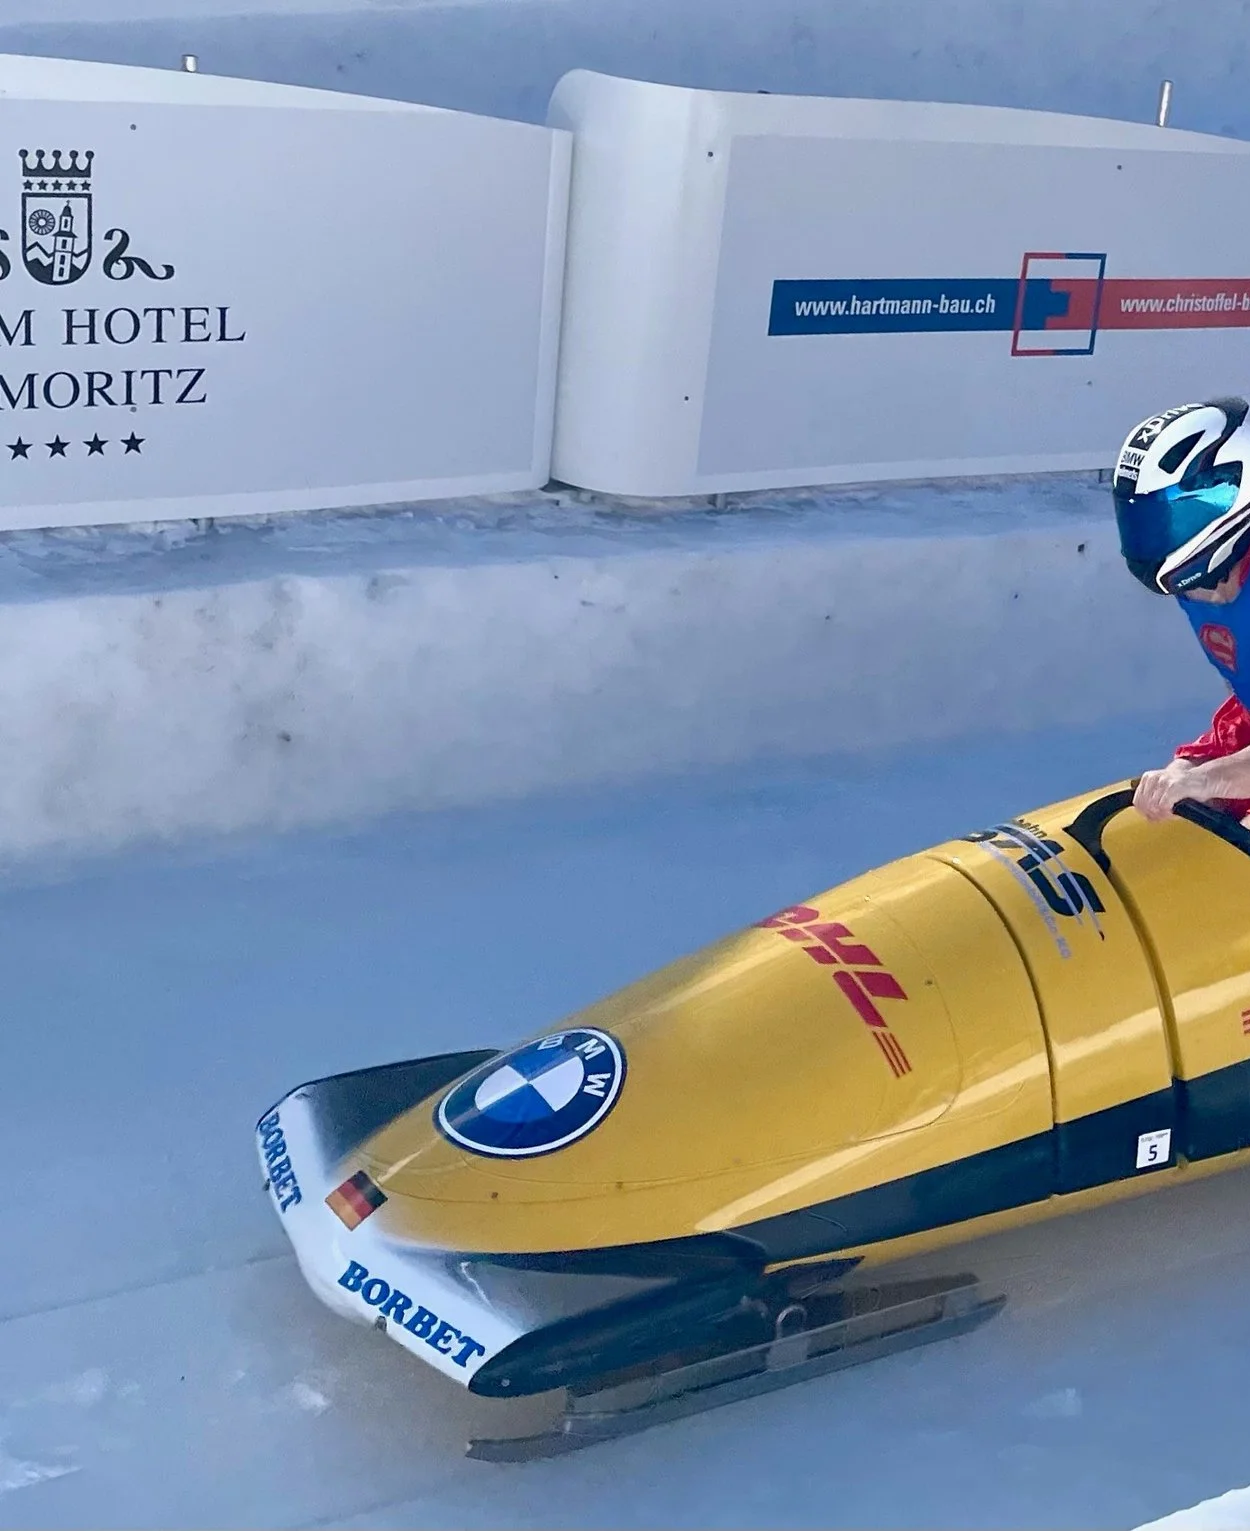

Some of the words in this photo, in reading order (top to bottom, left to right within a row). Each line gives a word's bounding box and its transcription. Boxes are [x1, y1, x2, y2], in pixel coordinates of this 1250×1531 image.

[61, 305, 247, 346] HOTEL
[795, 293, 997, 318] www.hartmann-bau.ch
[0, 367, 208, 411] MORITZ
[536, 1035, 612, 1098] BMW
[259, 1111, 302, 1214] BORBET
[1147, 1143, 1158, 1162] 5
[337, 1260, 486, 1368] BORBET
